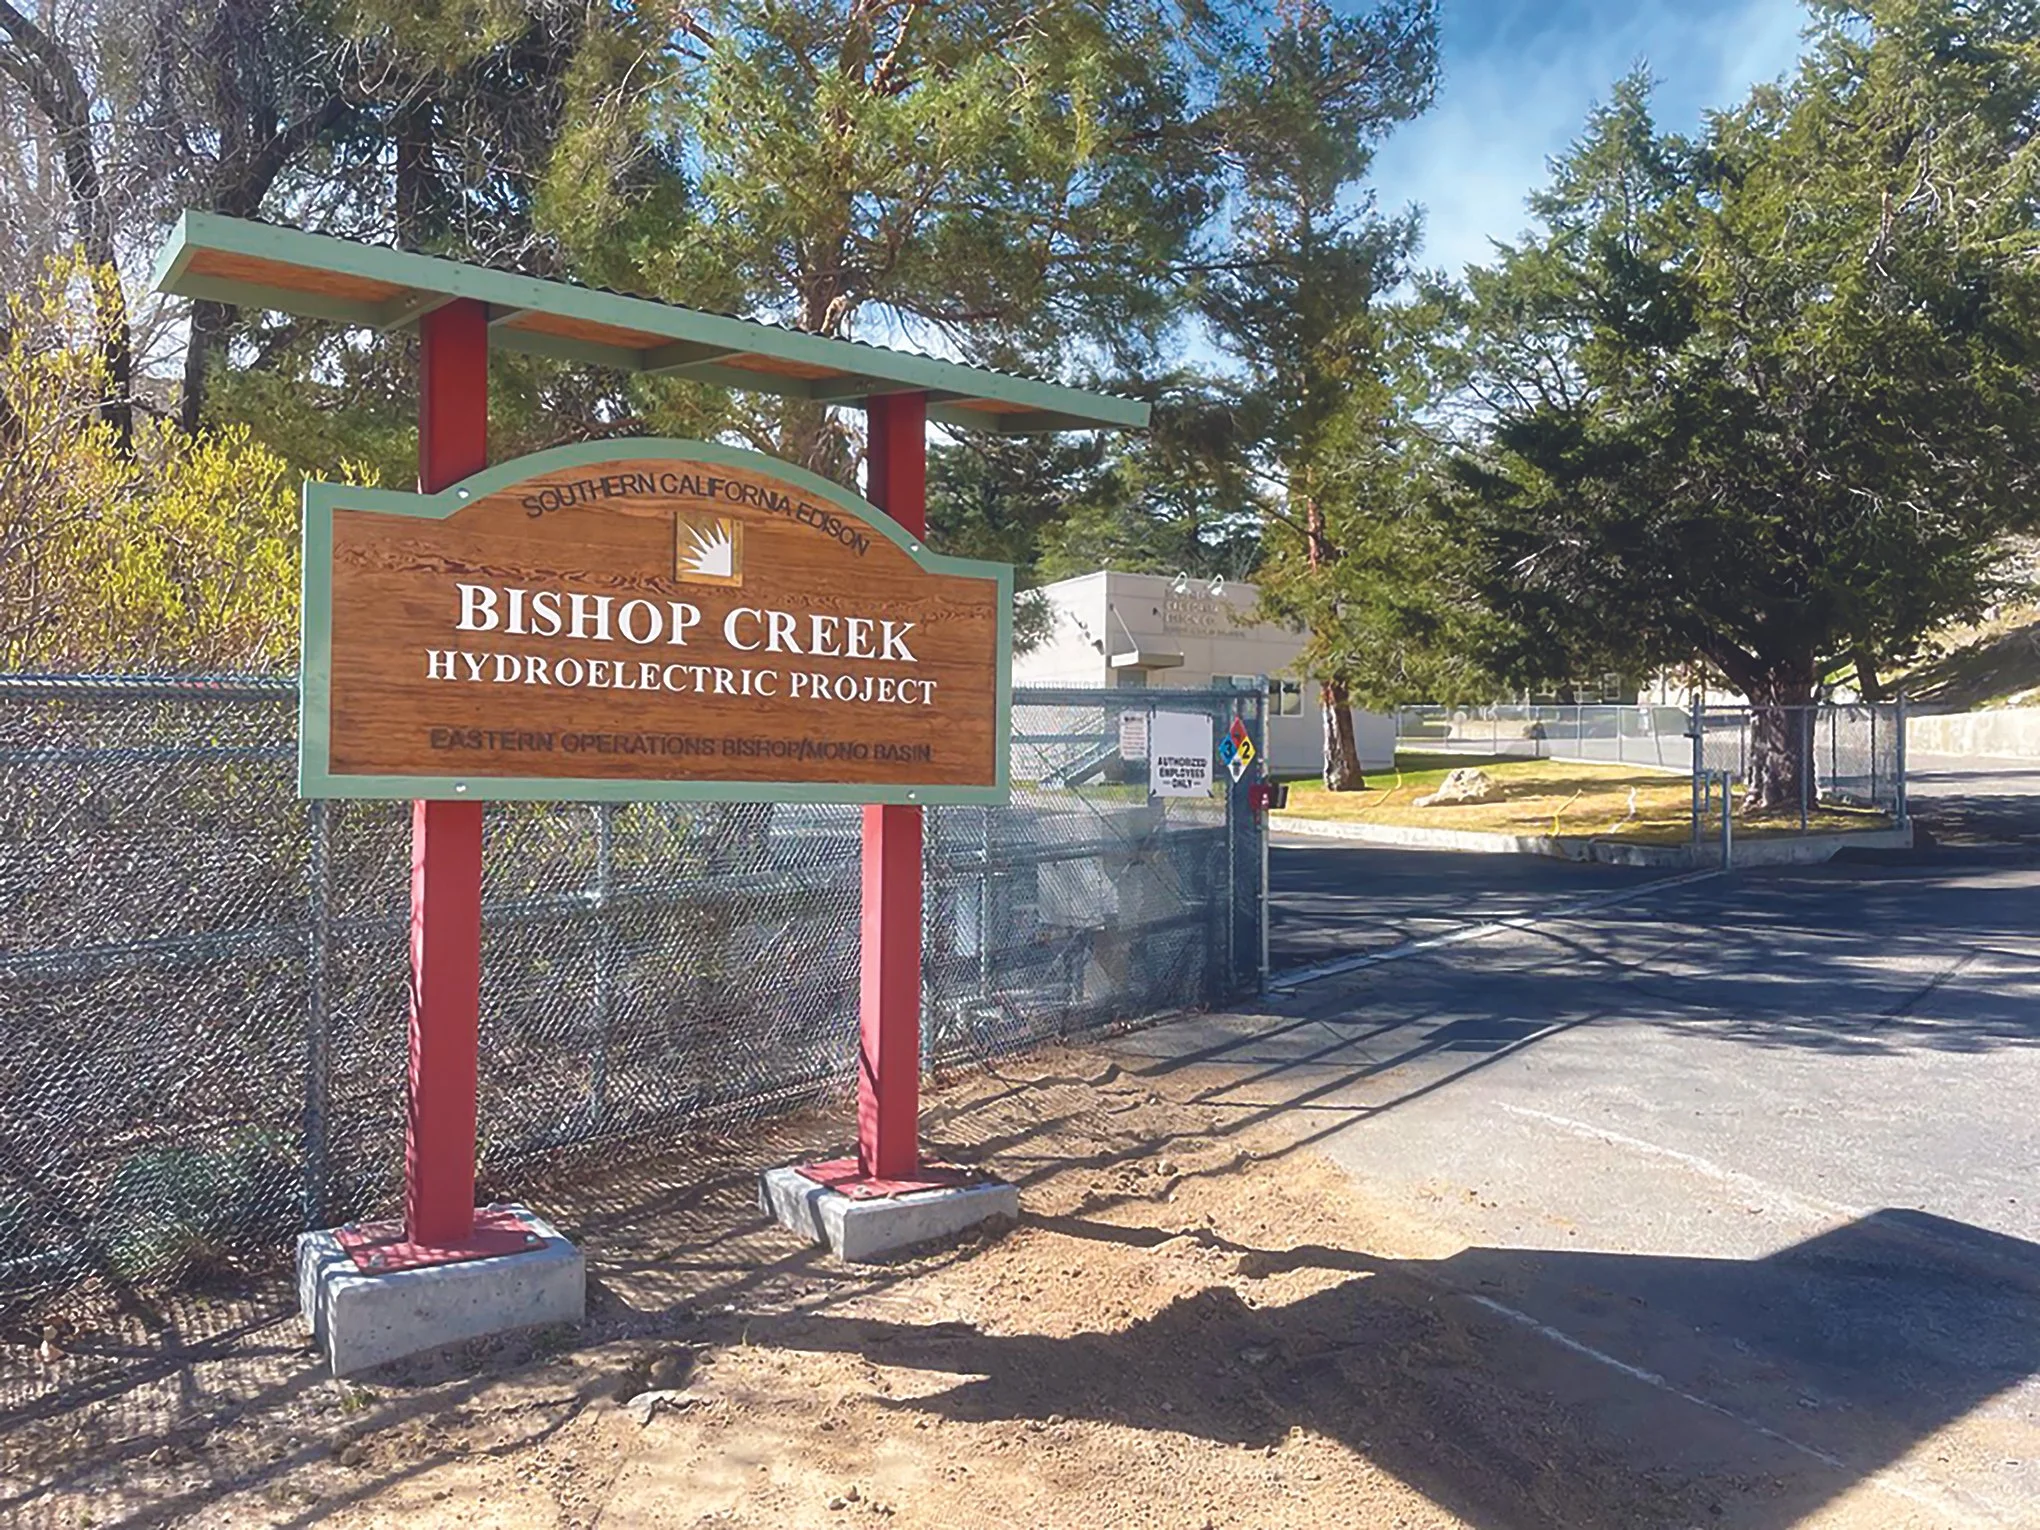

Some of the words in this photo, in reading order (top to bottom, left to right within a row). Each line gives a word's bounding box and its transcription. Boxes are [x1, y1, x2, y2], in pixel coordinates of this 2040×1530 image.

[522, 473, 656, 518] SOUTHERN
[660, 473, 791, 516] CALIFORNIA
[796, 502, 870, 556] EDISON
[456, 583, 701, 646] BISHOP
[724, 607, 918, 662] CREEK
[425, 649, 778, 697] HYDROELECTRIC
[790, 672, 937, 705] PROJECT
[430, 728, 554, 752] EASTERN
[560, 731, 715, 756] OPERATIONS
[722, 737, 868, 761] BISHOP/MONO
[873, 743, 932, 762] BASIN
[1224, 740, 1233, 759] 3
[1242, 740, 1251, 759] 2
[1158, 757, 1208, 768] AUTHORIZED
[1159, 767, 1205, 778] EMPLOYEES
[1171, 779, 1193, 789] ONLY
